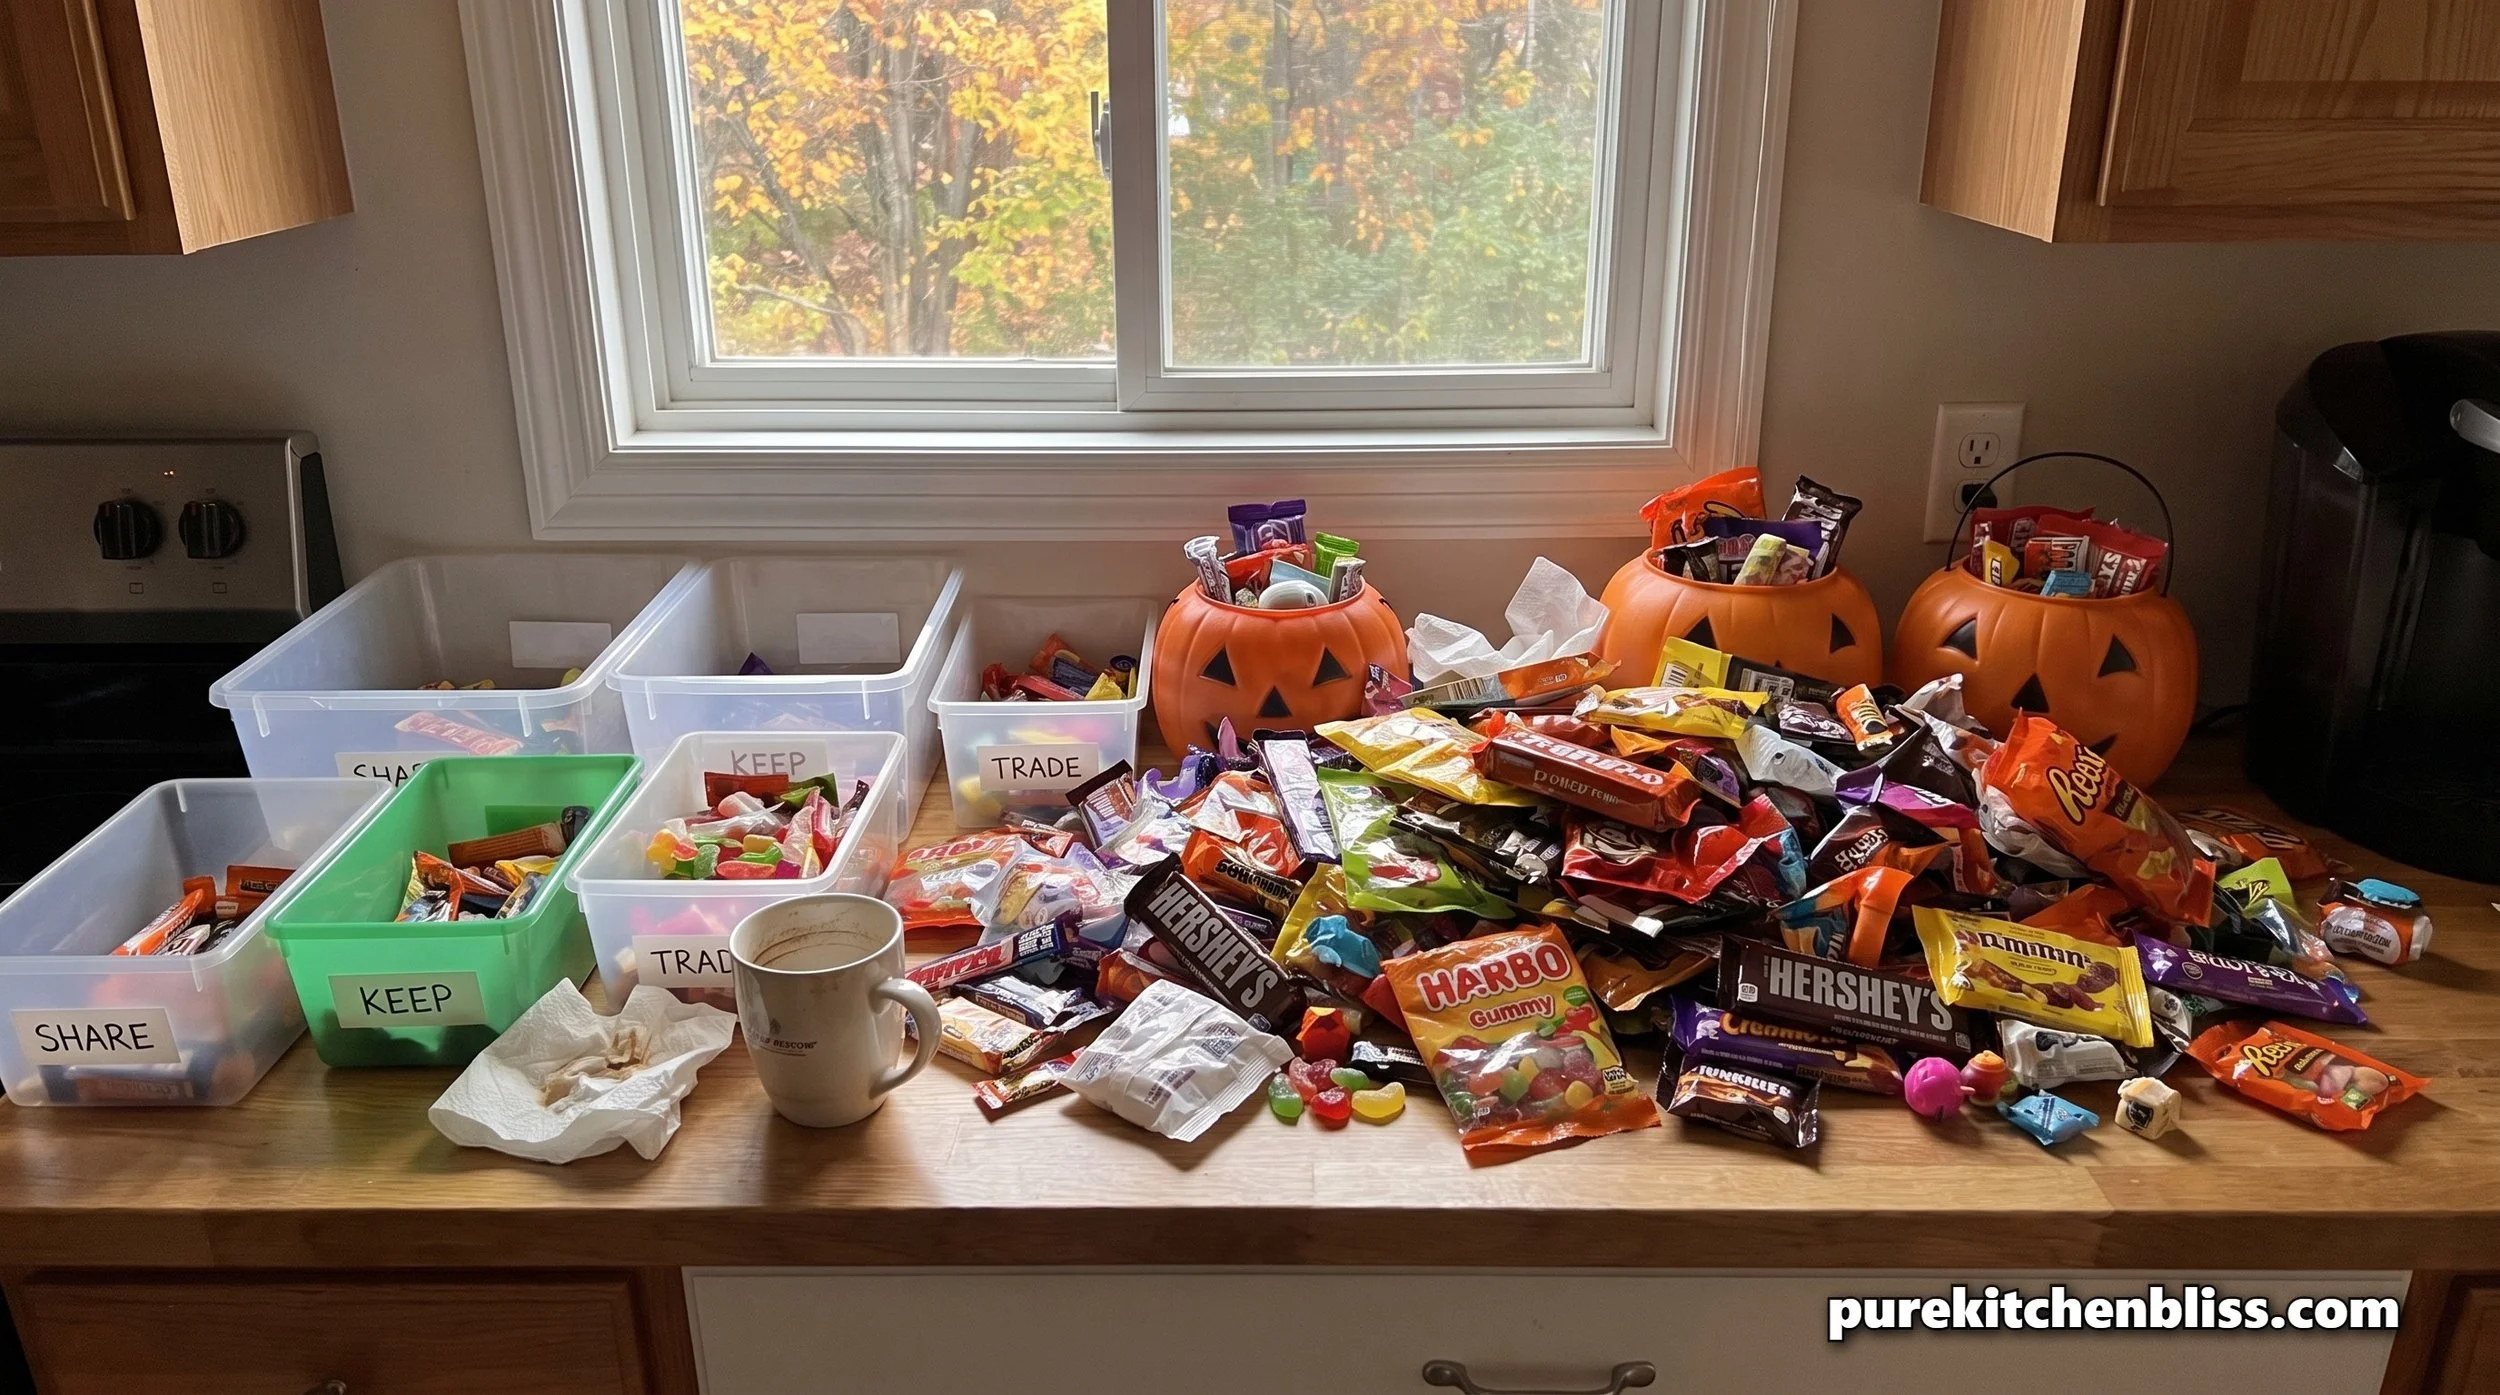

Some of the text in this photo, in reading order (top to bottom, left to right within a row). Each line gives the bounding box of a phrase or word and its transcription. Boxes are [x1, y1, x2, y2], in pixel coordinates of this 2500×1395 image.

[353, 763, 421, 788] SHA
[731, 749, 806, 776] KEEP
[991, 756, 1082, 779] TRADE
[1147, 881, 1279, 1008] HERSHEY'S
[650, 949, 732, 975] TRAD
[360, 984, 452, 1015] KEEP
[1769, 956, 1953, 1031] HERSHEY'S
[1468, 994, 1552, 1029] Gummy
[35, 1023, 155, 1052] SHARE
